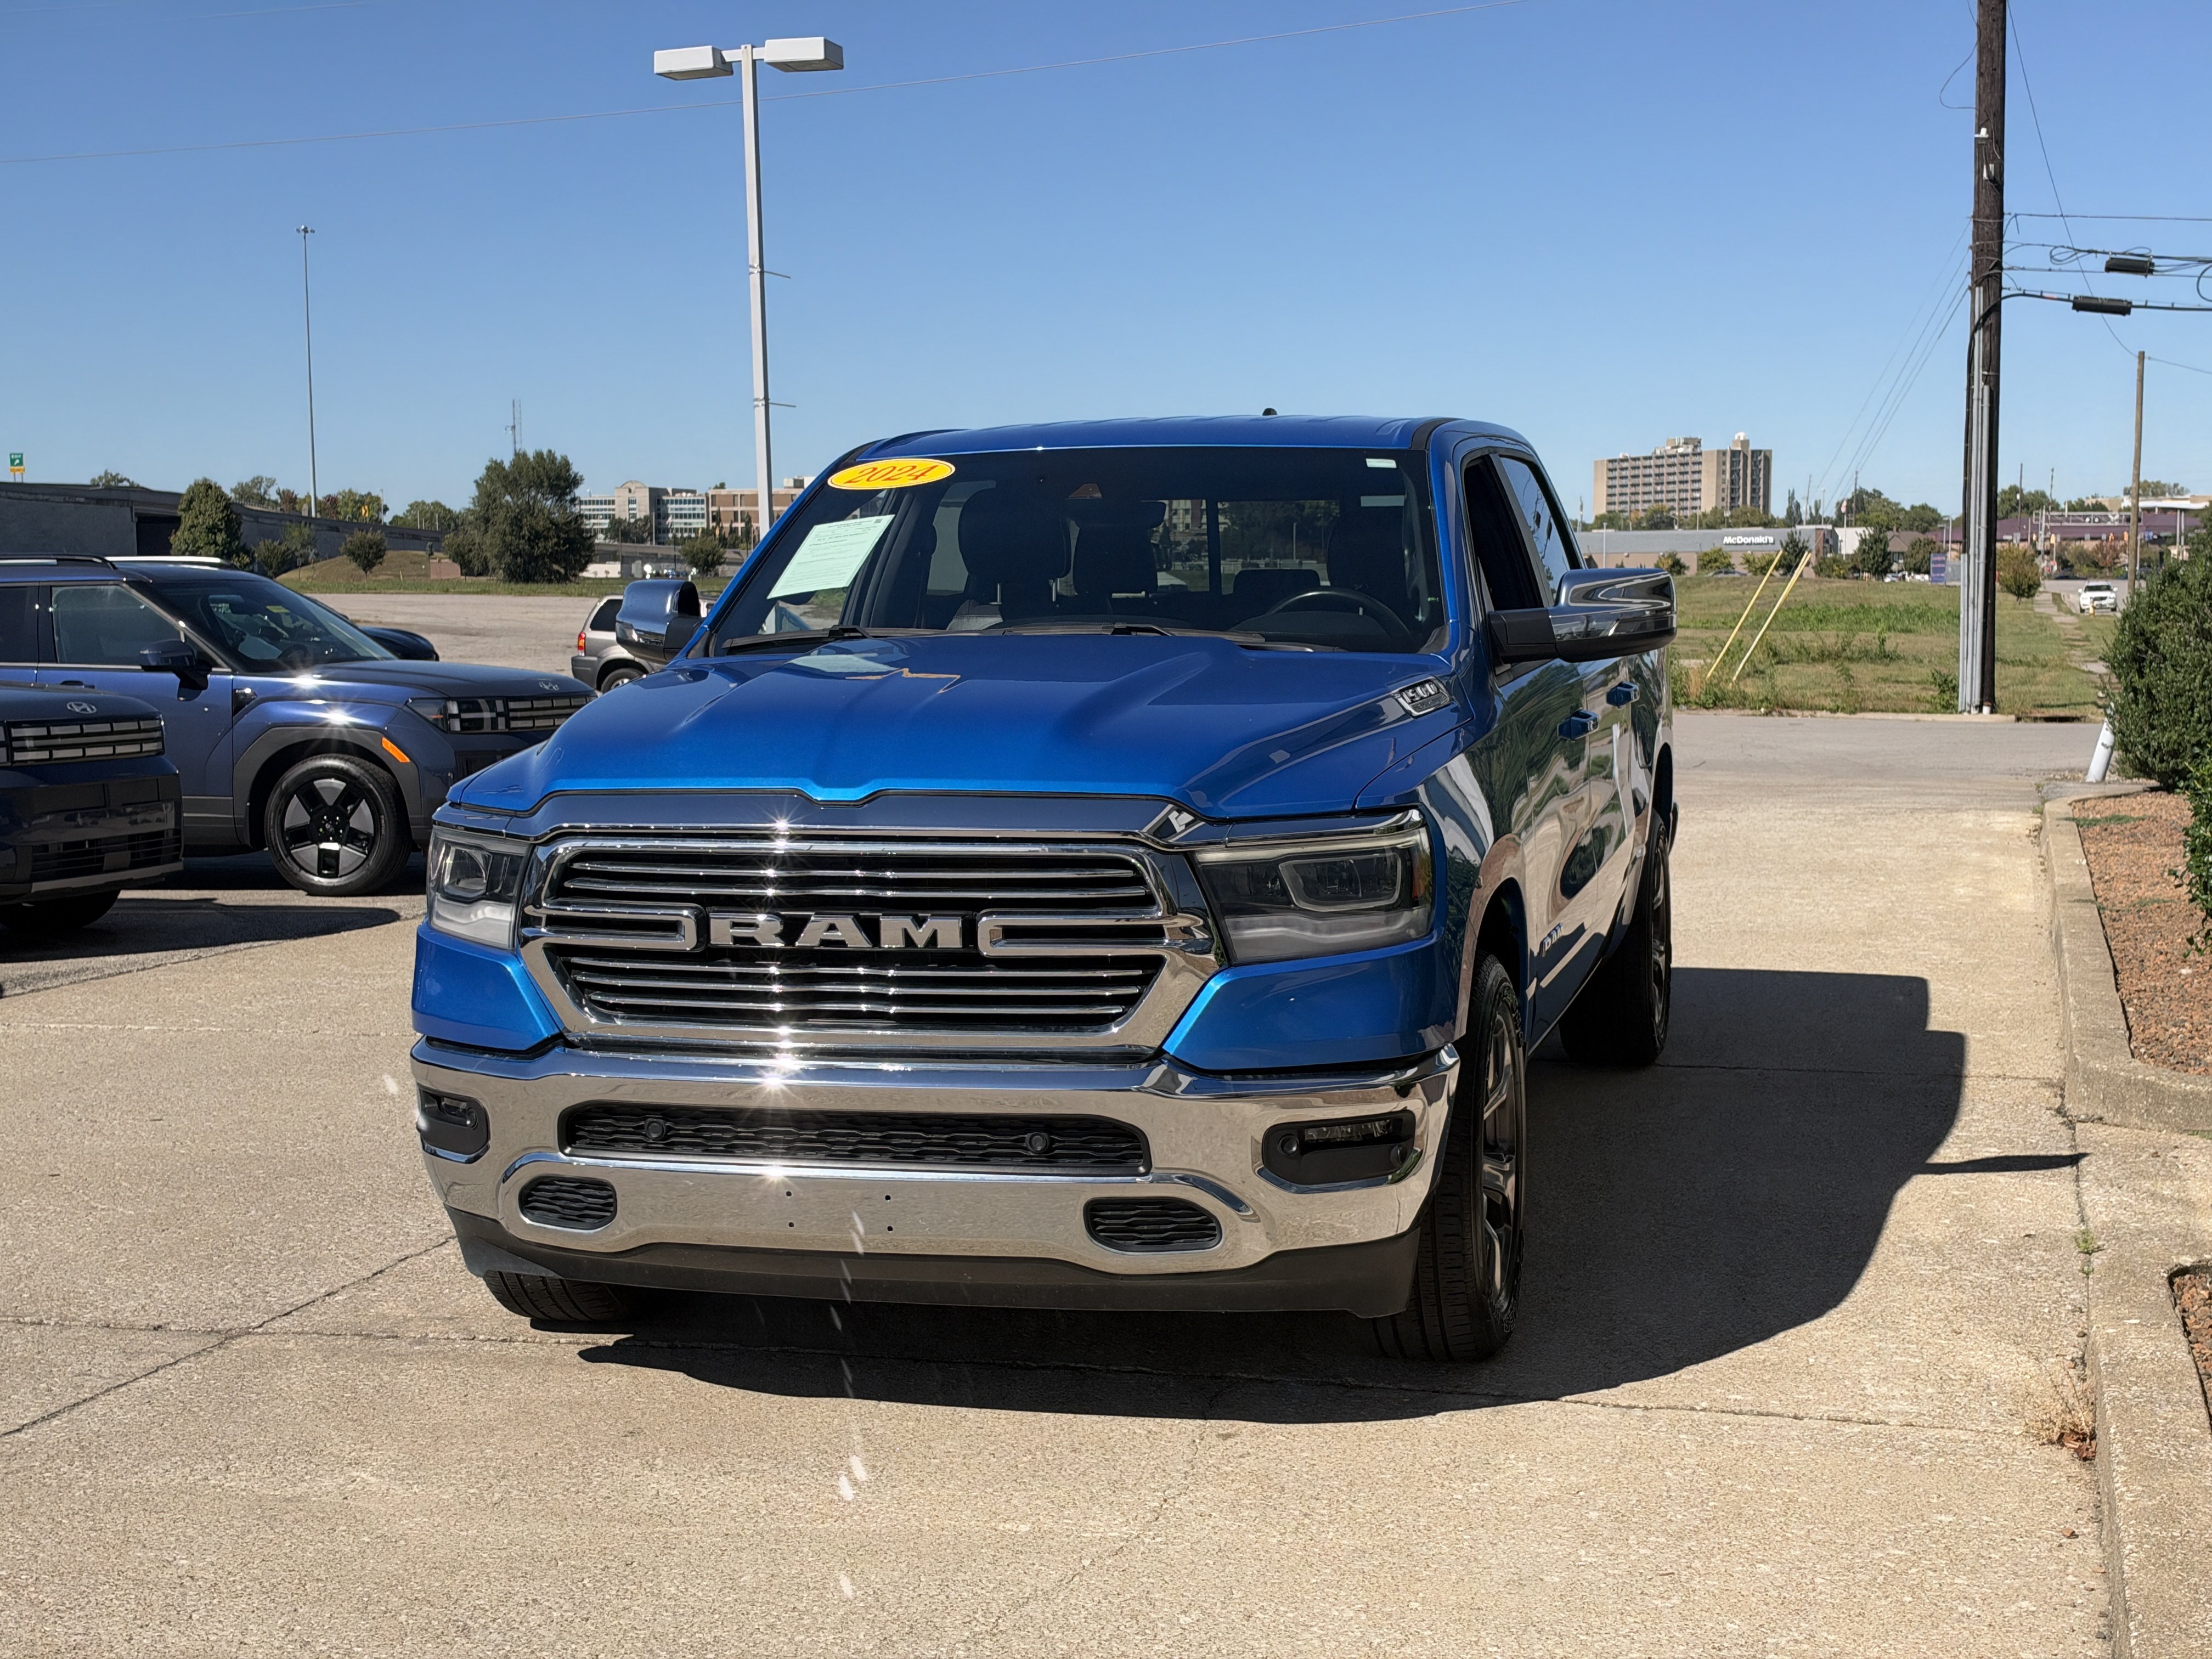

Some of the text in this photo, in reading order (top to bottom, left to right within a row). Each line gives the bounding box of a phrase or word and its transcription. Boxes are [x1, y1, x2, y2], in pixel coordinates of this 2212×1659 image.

[843, 465, 939, 484] 2024
[1723, 535, 1774, 544] McDonald's
[1401, 681, 1437, 703] 1500
[710, 913, 962, 948] RAM
